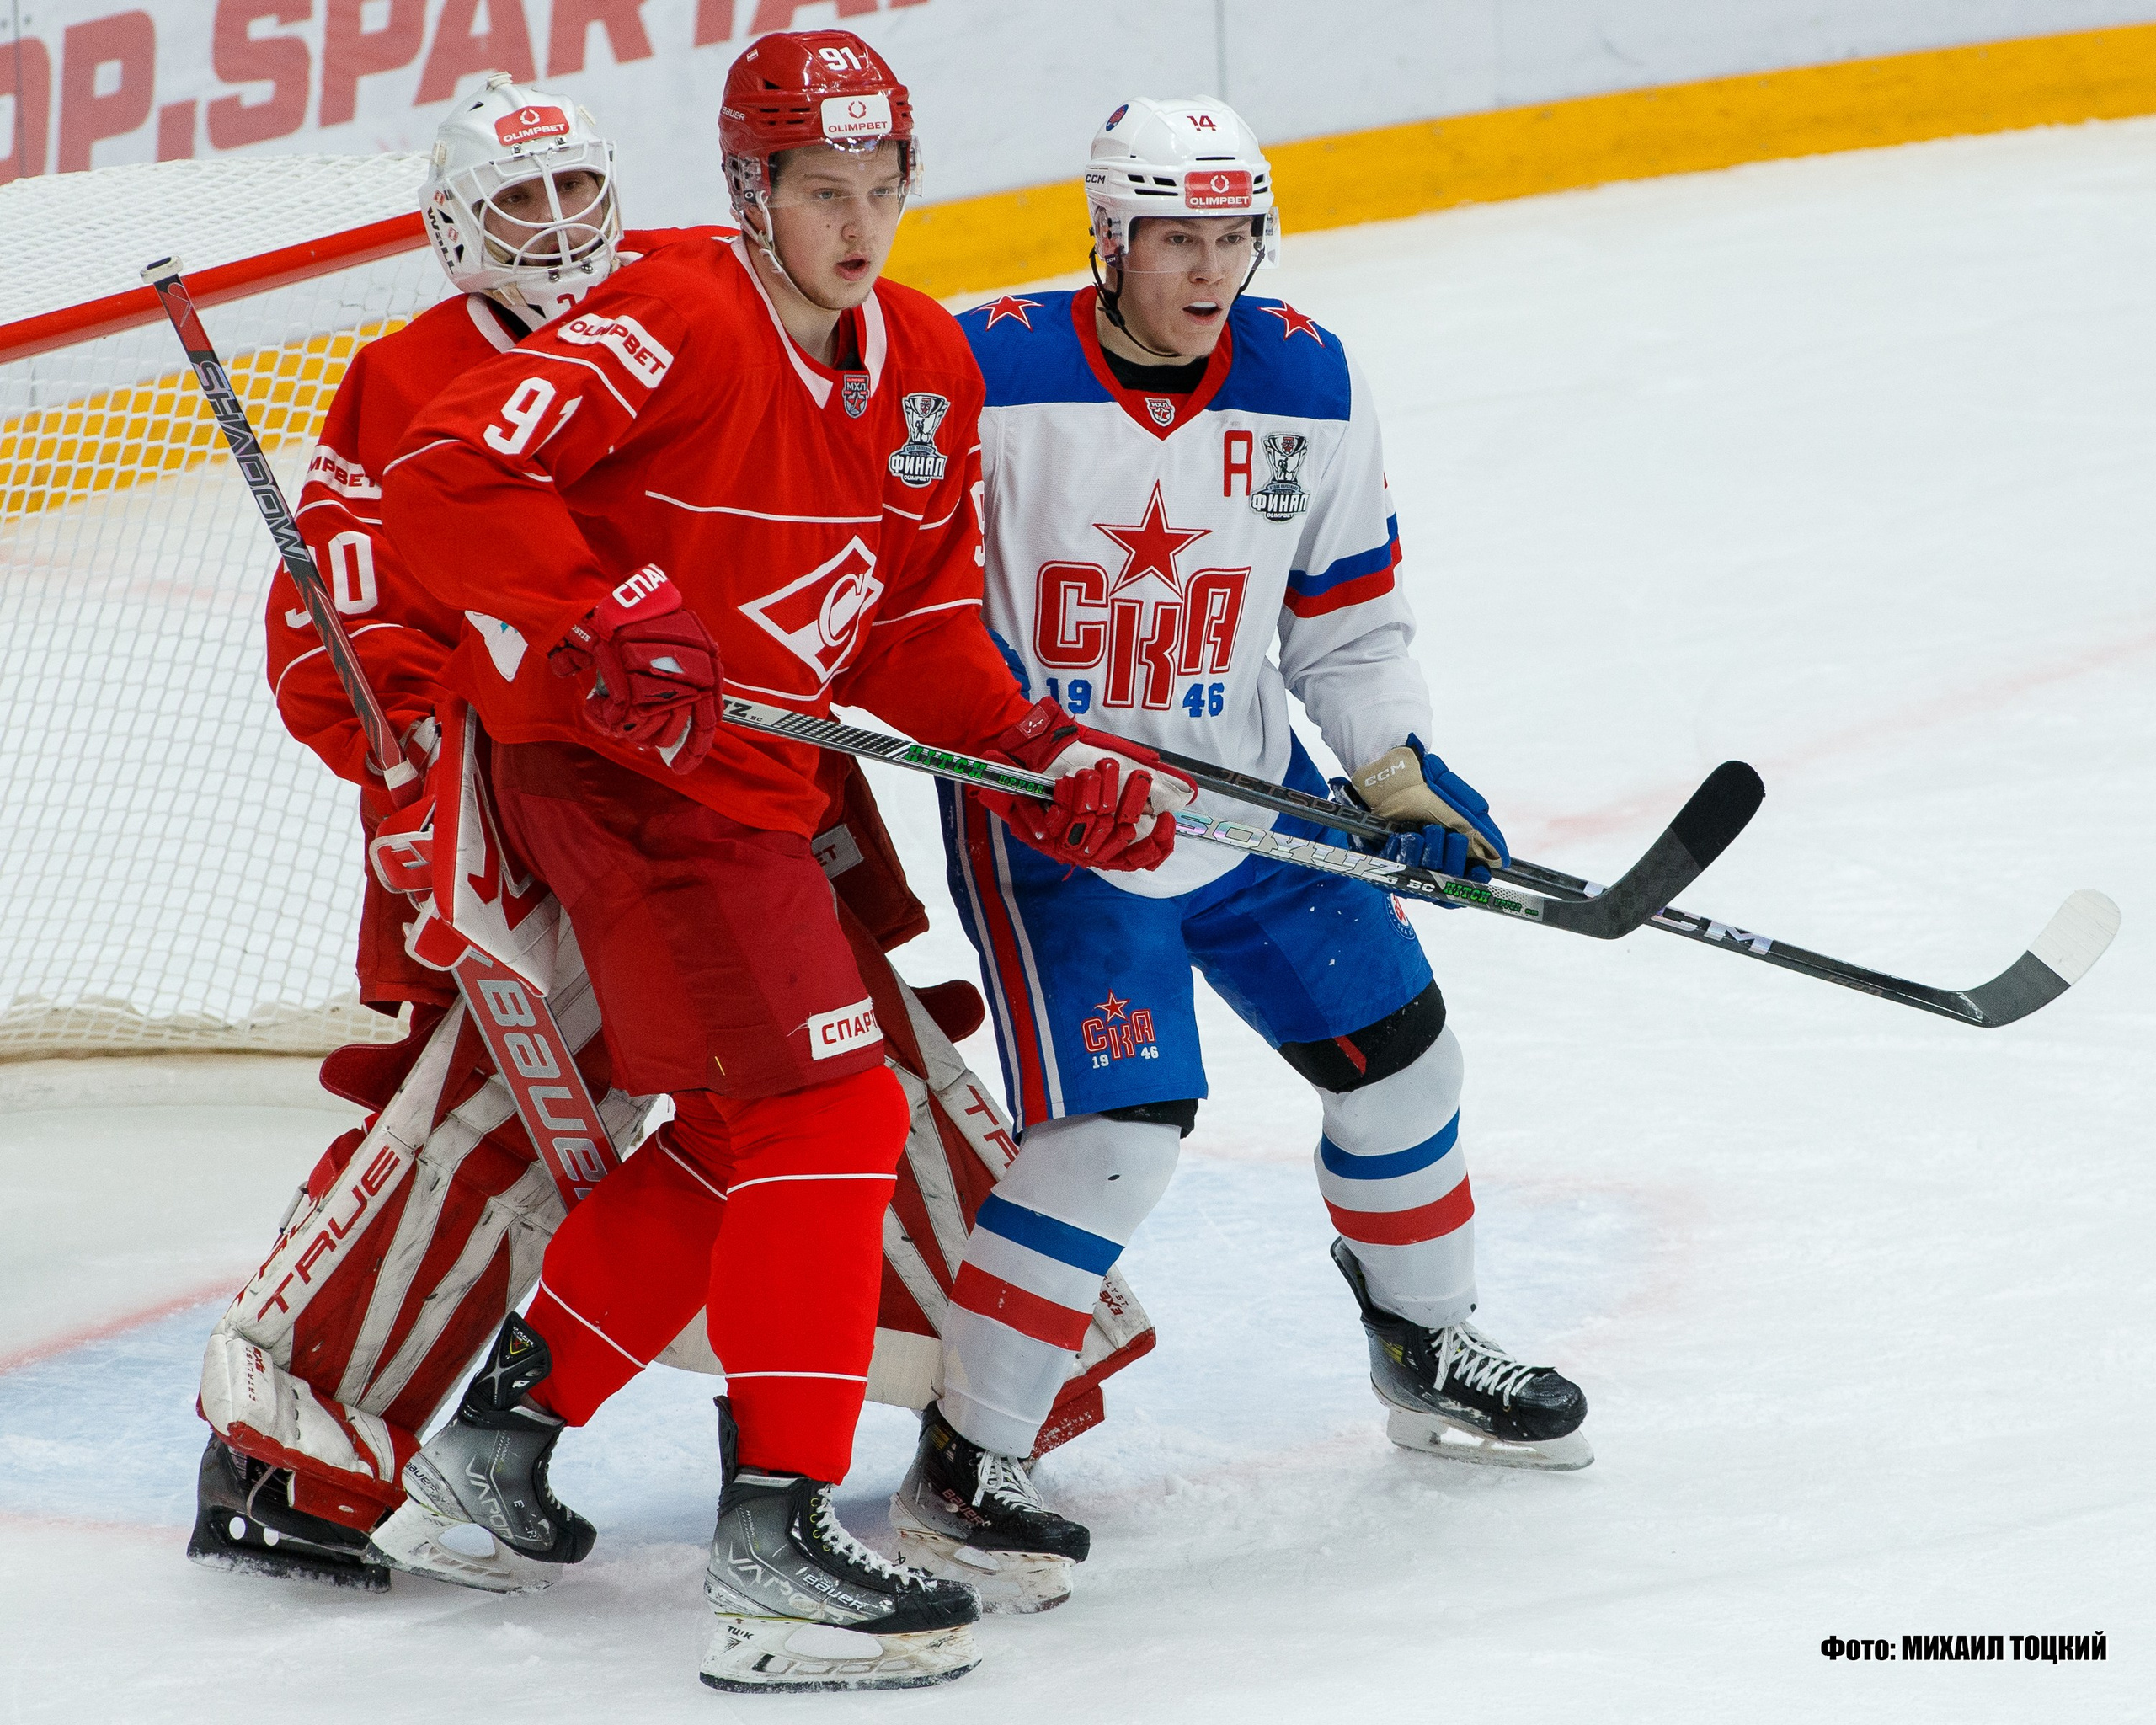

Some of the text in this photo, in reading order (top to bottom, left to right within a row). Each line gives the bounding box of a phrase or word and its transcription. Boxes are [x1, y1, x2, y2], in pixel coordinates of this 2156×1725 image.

[818, 46, 862, 71] 91
[503, 123, 565, 142] OLIMPBET
[828, 121, 889, 133] OLIMPBET
[1186, 115, 1217, 131] 14
[1085, 174, 1106, 184] CCM
[1189, 196, 1250, 206] OLIMPBET
[846, 382, 867, 391] МХЛ
[190, 360, 311, 563] SHADOW
[891, 454, 945, 477] ФИНАЛ
[1223, 430, 1253, 498] A
[1251, 493, 1310, 513] ФИНАЛ
[1033, 559, 1252, 710] СКА
[1045, 677, 1225, 718] 19 46
[904, 744, 989, 780] HITCH
[997, 774, 1045, 795] UPPER
[1364, 760, 1406, 788] CCM
[1176, 810, 1407, 884] SOYUZ
[1406, 879, 1436, 894] BC
[1443, 880, 1493, 905] HITCH
[1081, 1009, 1156, 1060] СКА
[1091, 1045, 1160, 1070] 19 46
[477, 979, 609, 1200] BAUE
[257, 1144, 401, 1322] TRUE
[803, 1573, 865, 1611] BAUER
